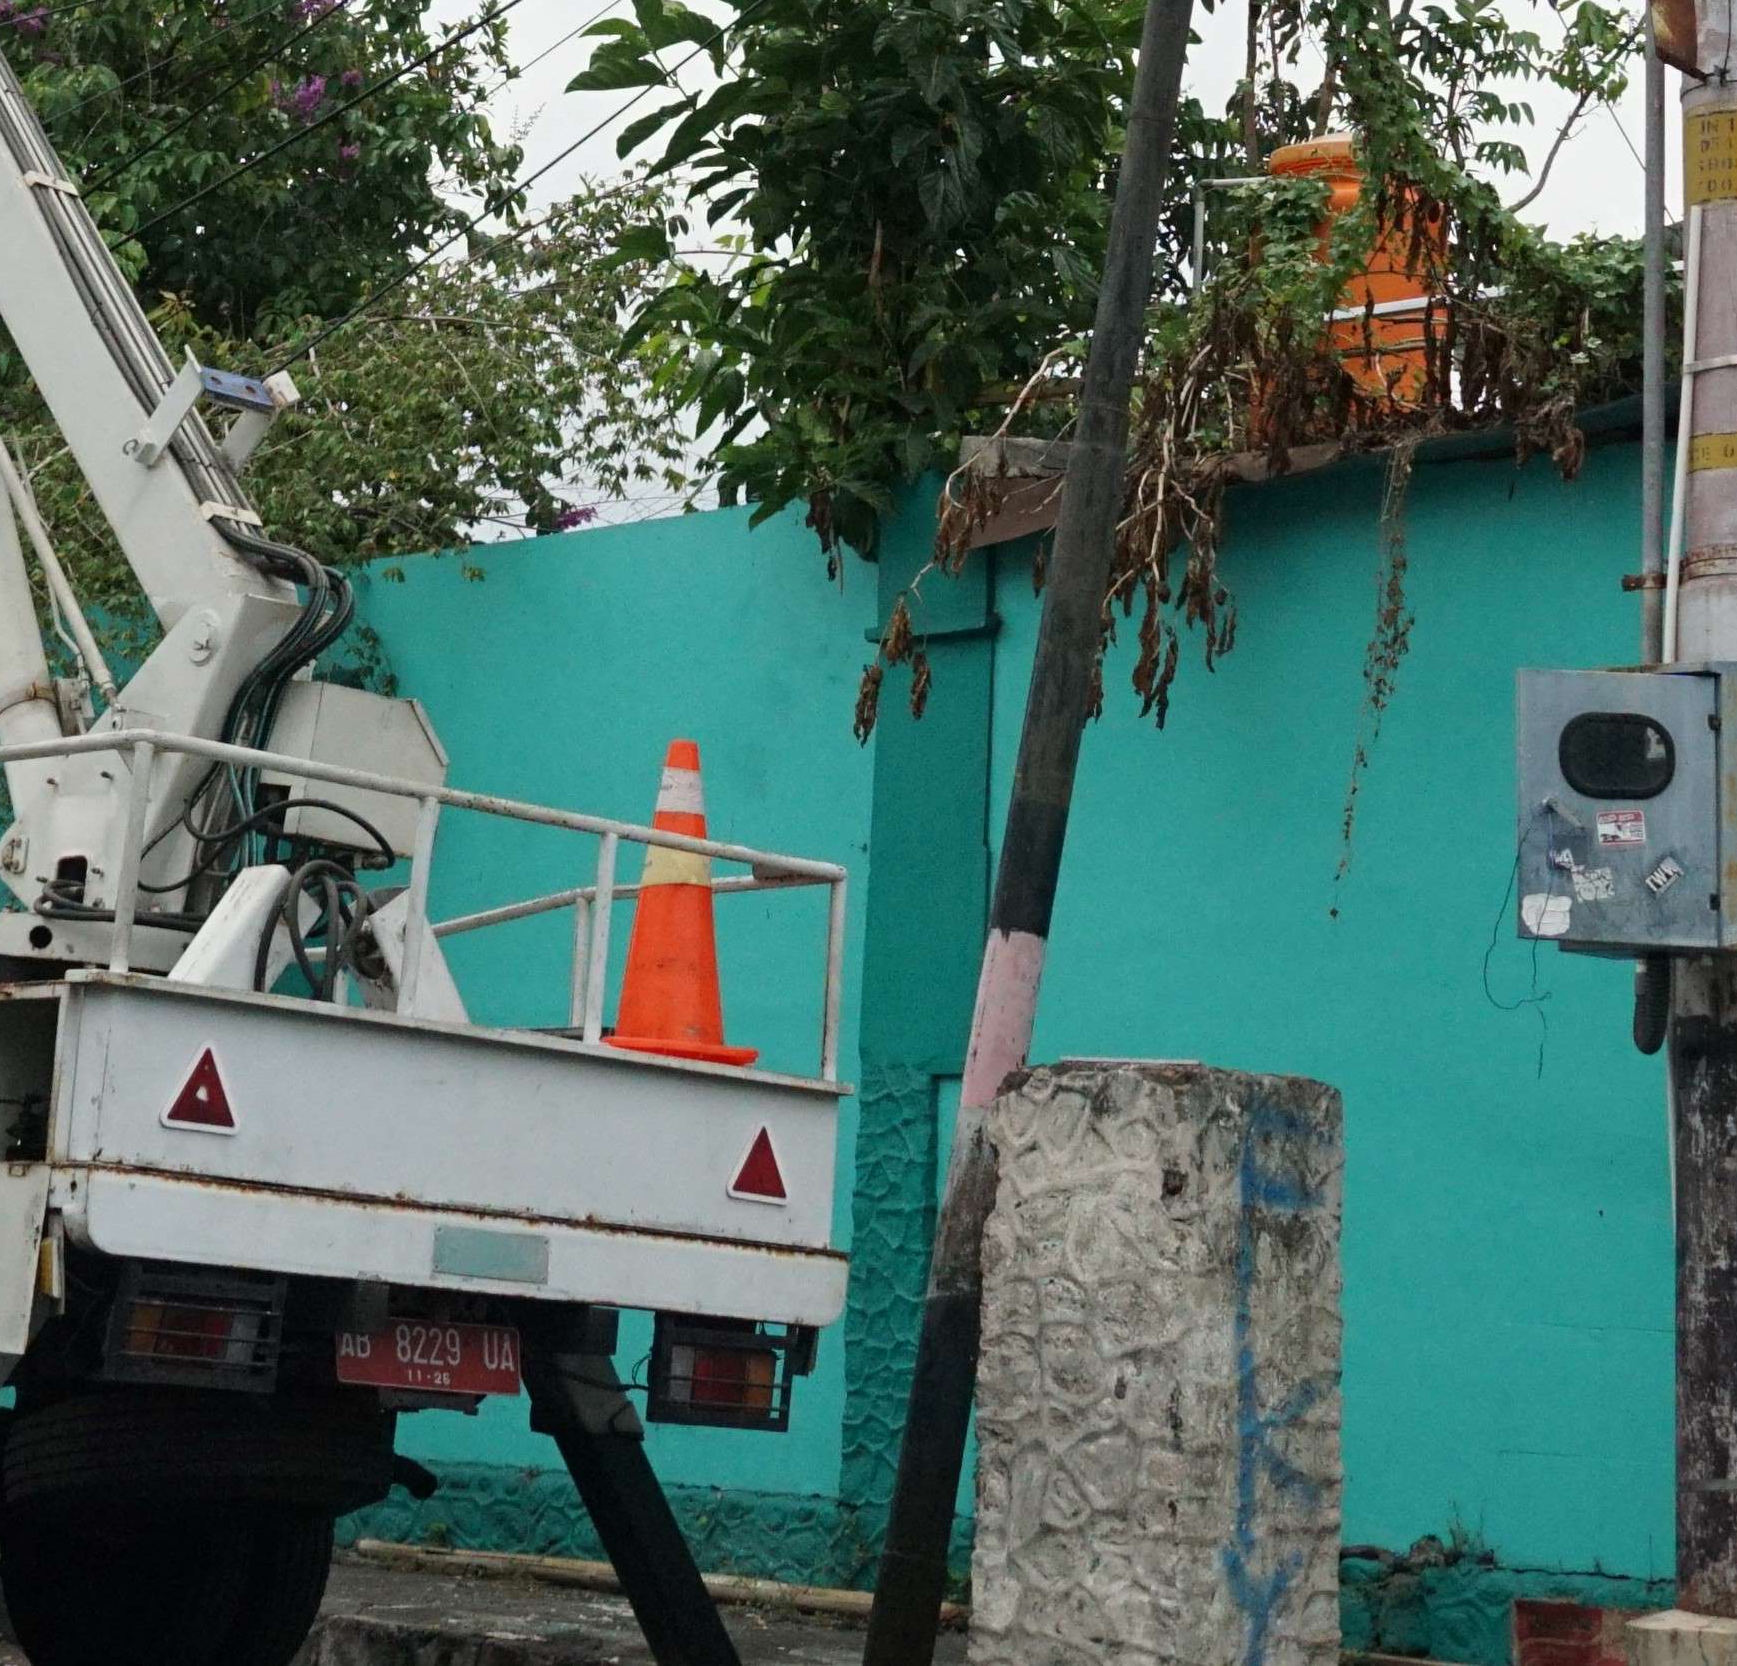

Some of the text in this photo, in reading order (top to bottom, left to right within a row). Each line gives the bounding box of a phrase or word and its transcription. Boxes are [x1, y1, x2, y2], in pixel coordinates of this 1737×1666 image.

[340, 1324, 515, 1372] AB 8229 UA
